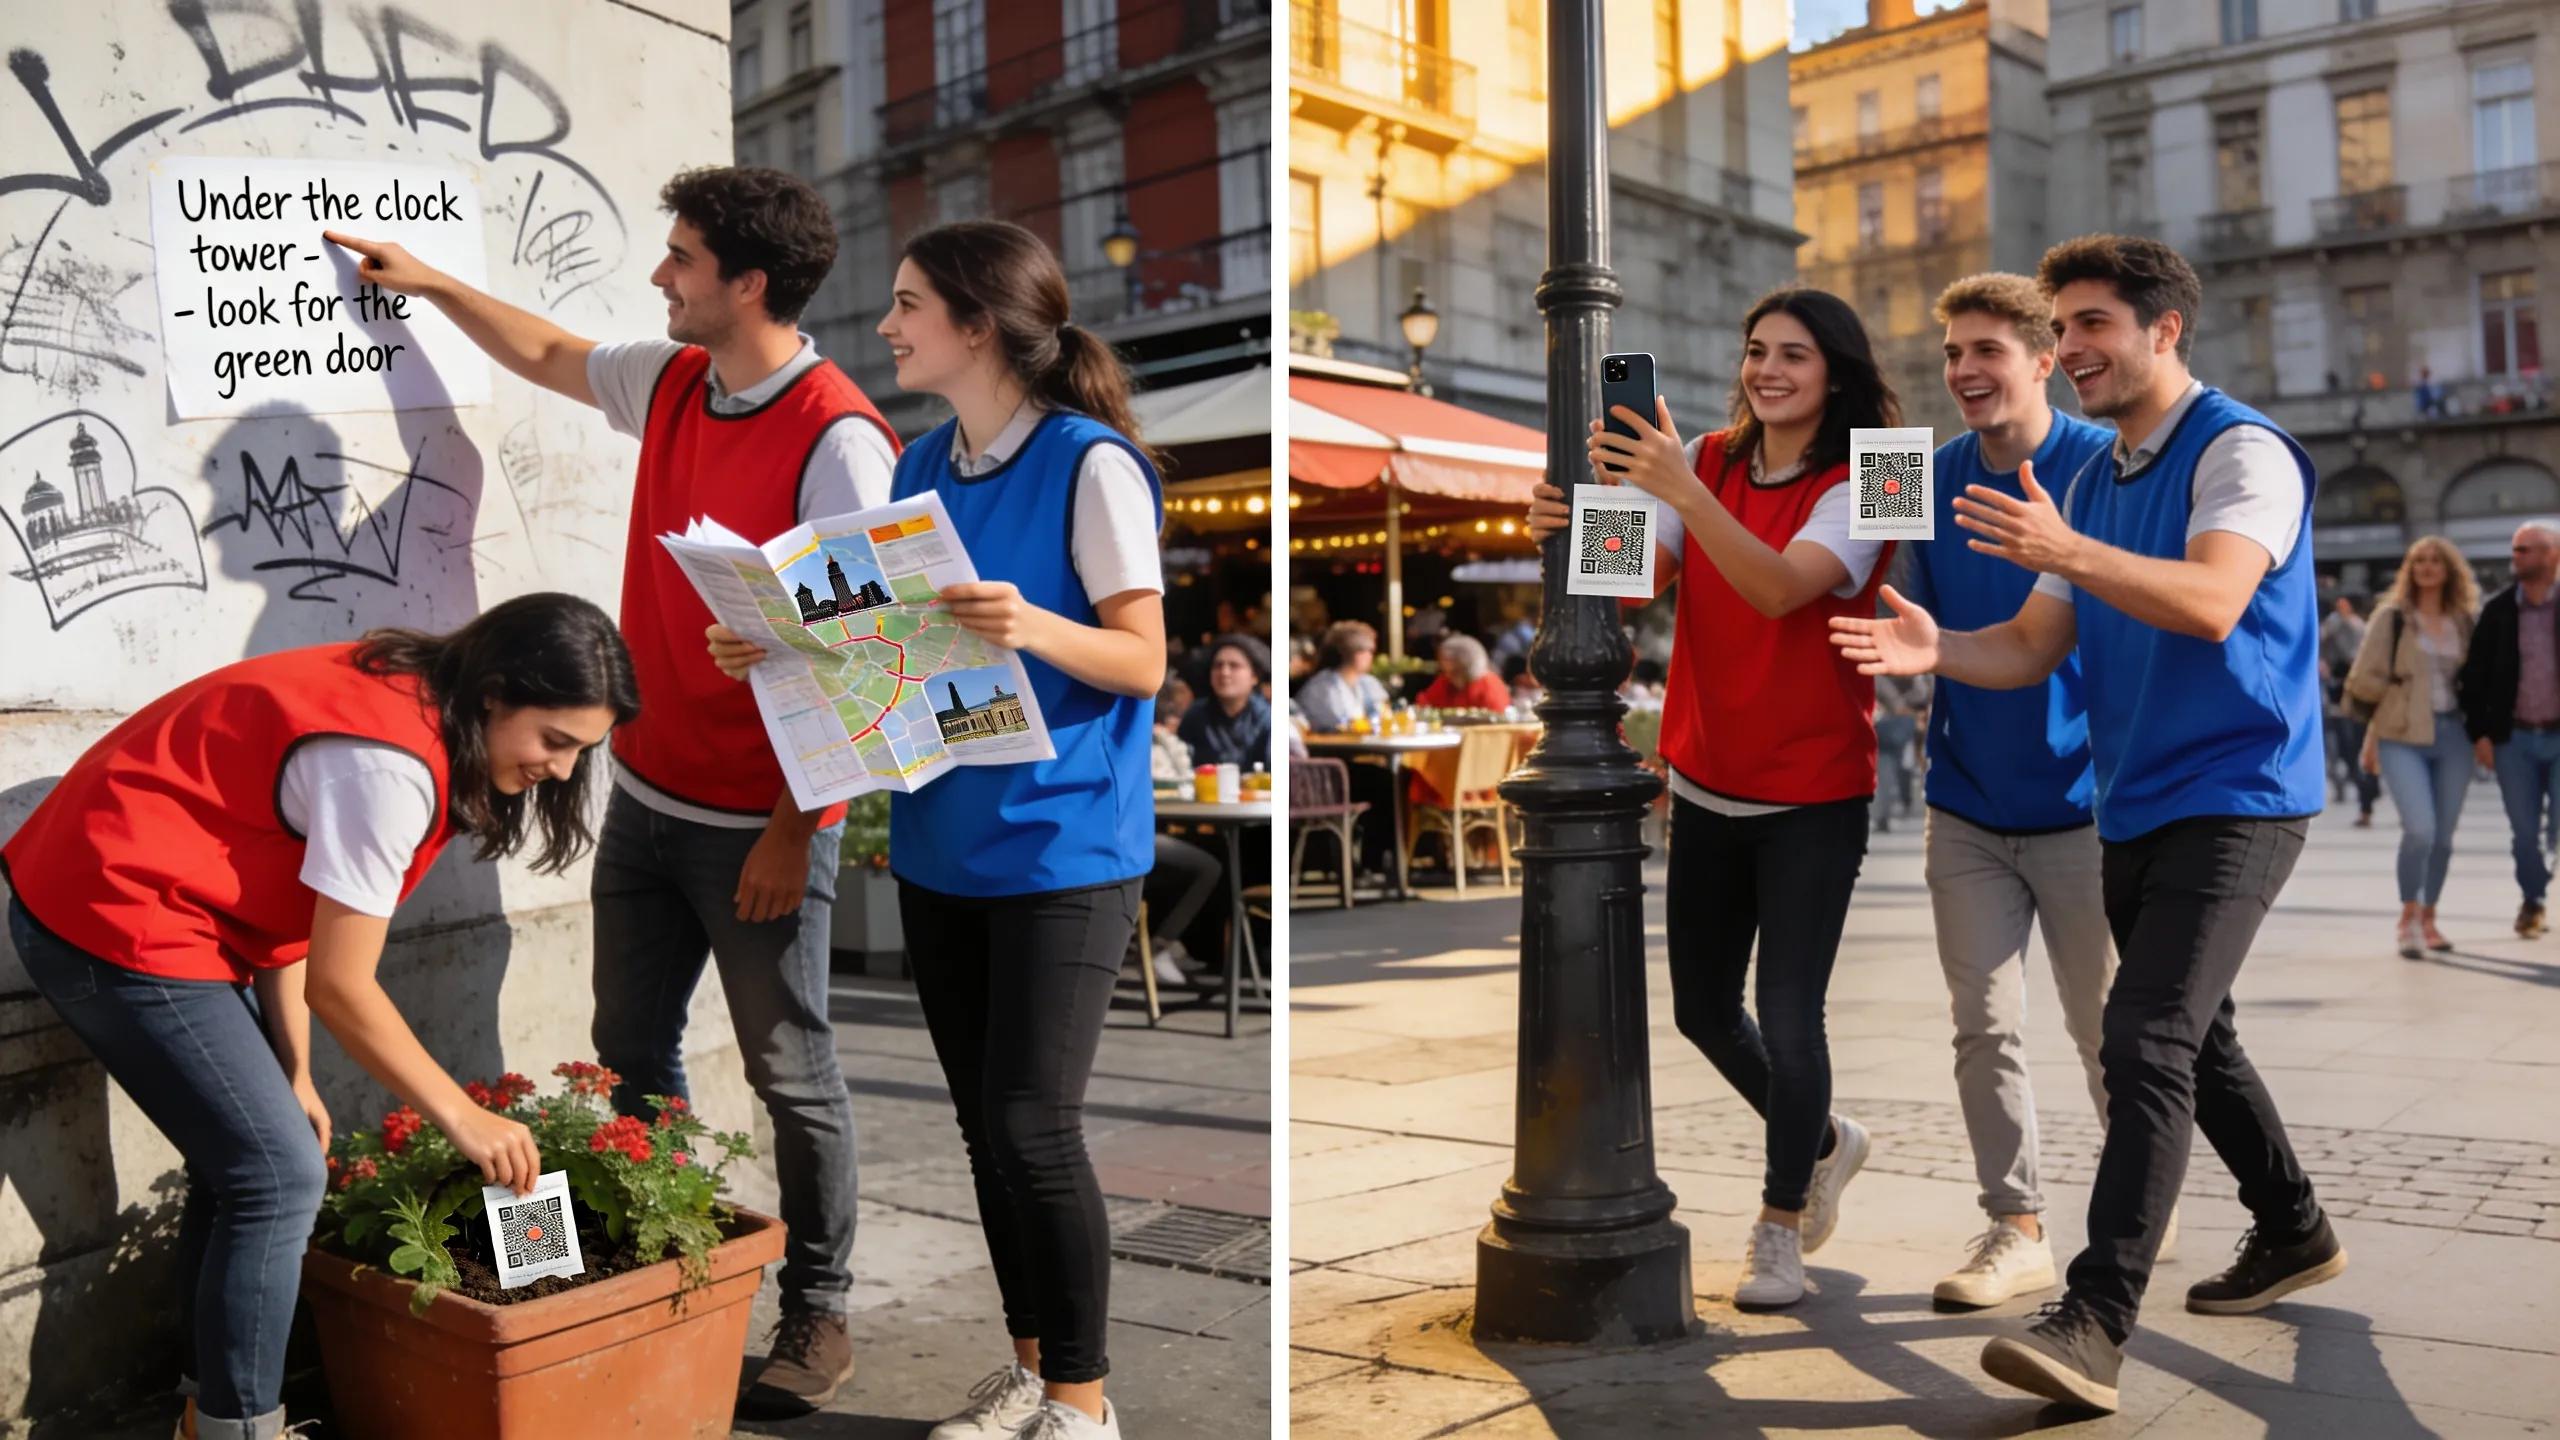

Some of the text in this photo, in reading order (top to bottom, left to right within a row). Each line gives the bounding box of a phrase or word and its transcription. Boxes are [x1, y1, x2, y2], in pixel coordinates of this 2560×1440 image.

[178, 176, 463, 222] Under the clock
[207, 286, 280, 329] look
[288, 281, 344, 327] for
[352, 282, 412, 323] the
[214, 332, 406, 400] green door
